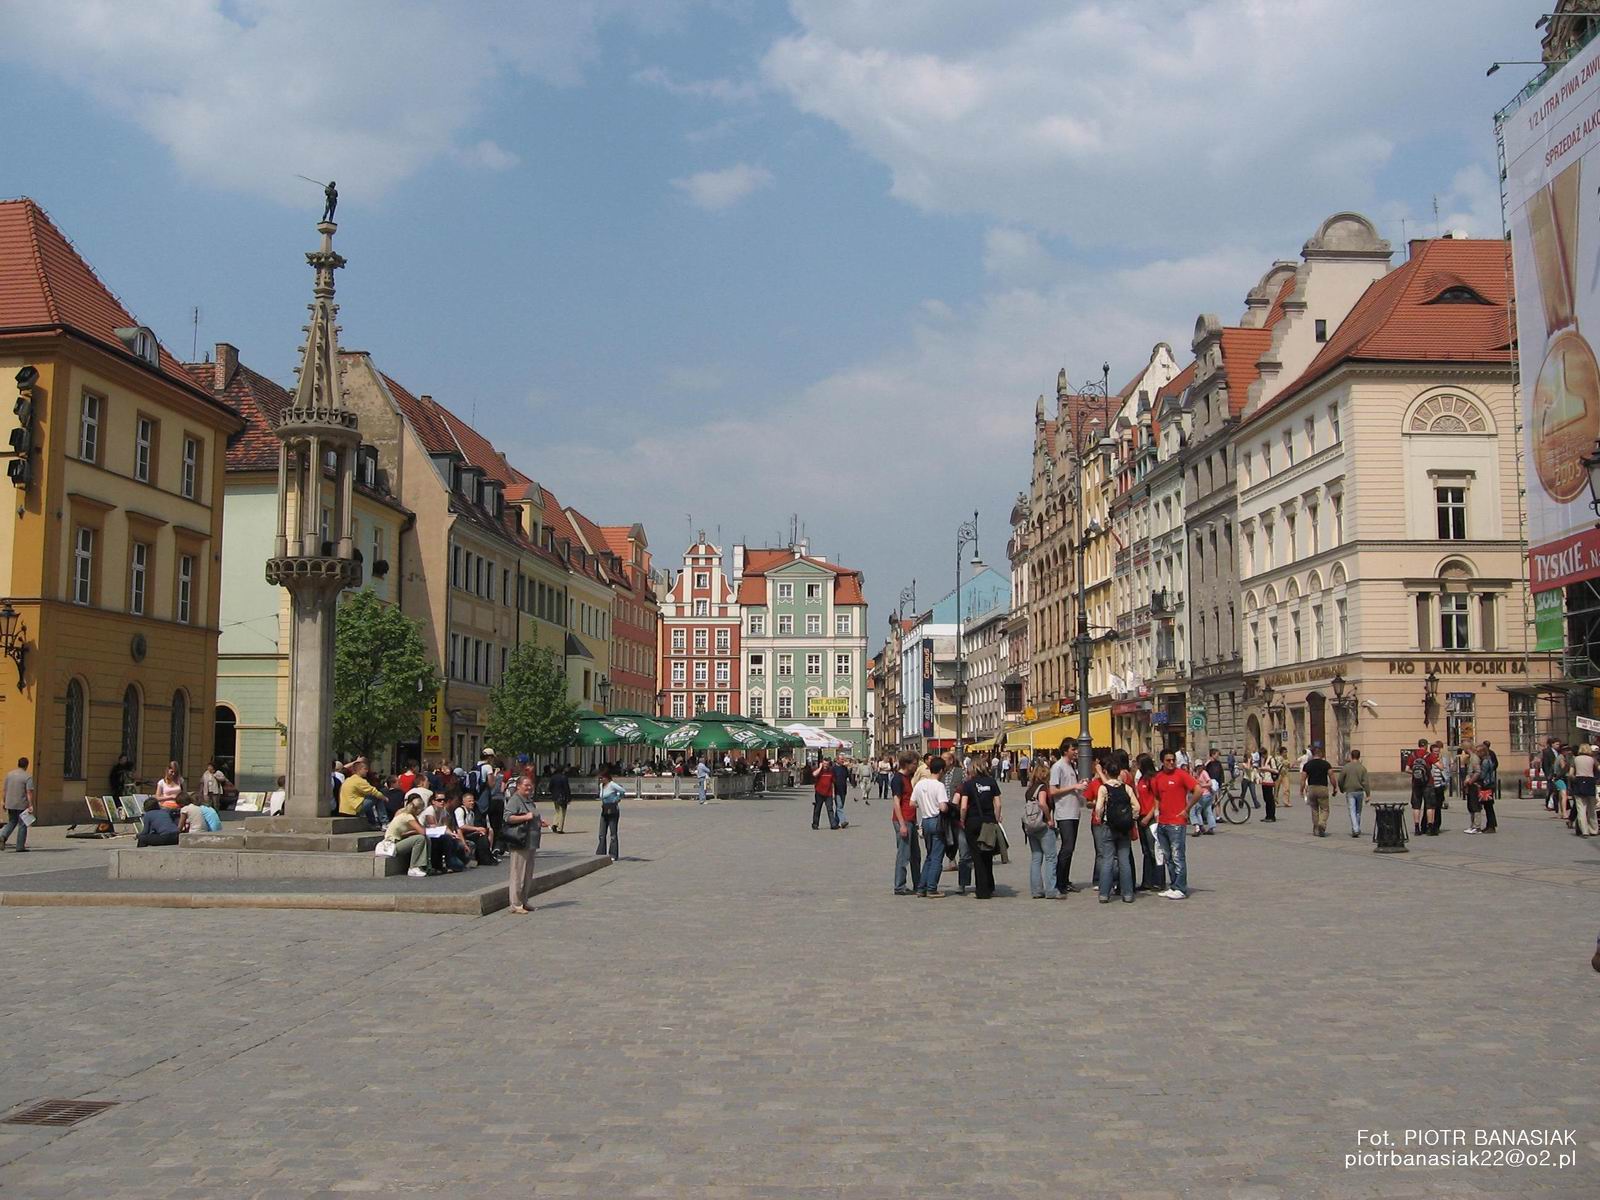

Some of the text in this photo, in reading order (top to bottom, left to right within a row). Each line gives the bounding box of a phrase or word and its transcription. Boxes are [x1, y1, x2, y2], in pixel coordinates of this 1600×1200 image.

[1540, 92, 1560, 119] LITRA
[1561, 75, 1580, 102] PIWA
[1545, 123, 1581, 167] SPRZEDAŻ
[1389, 661, 1527, 674] PKO BANK POLSKI SA
